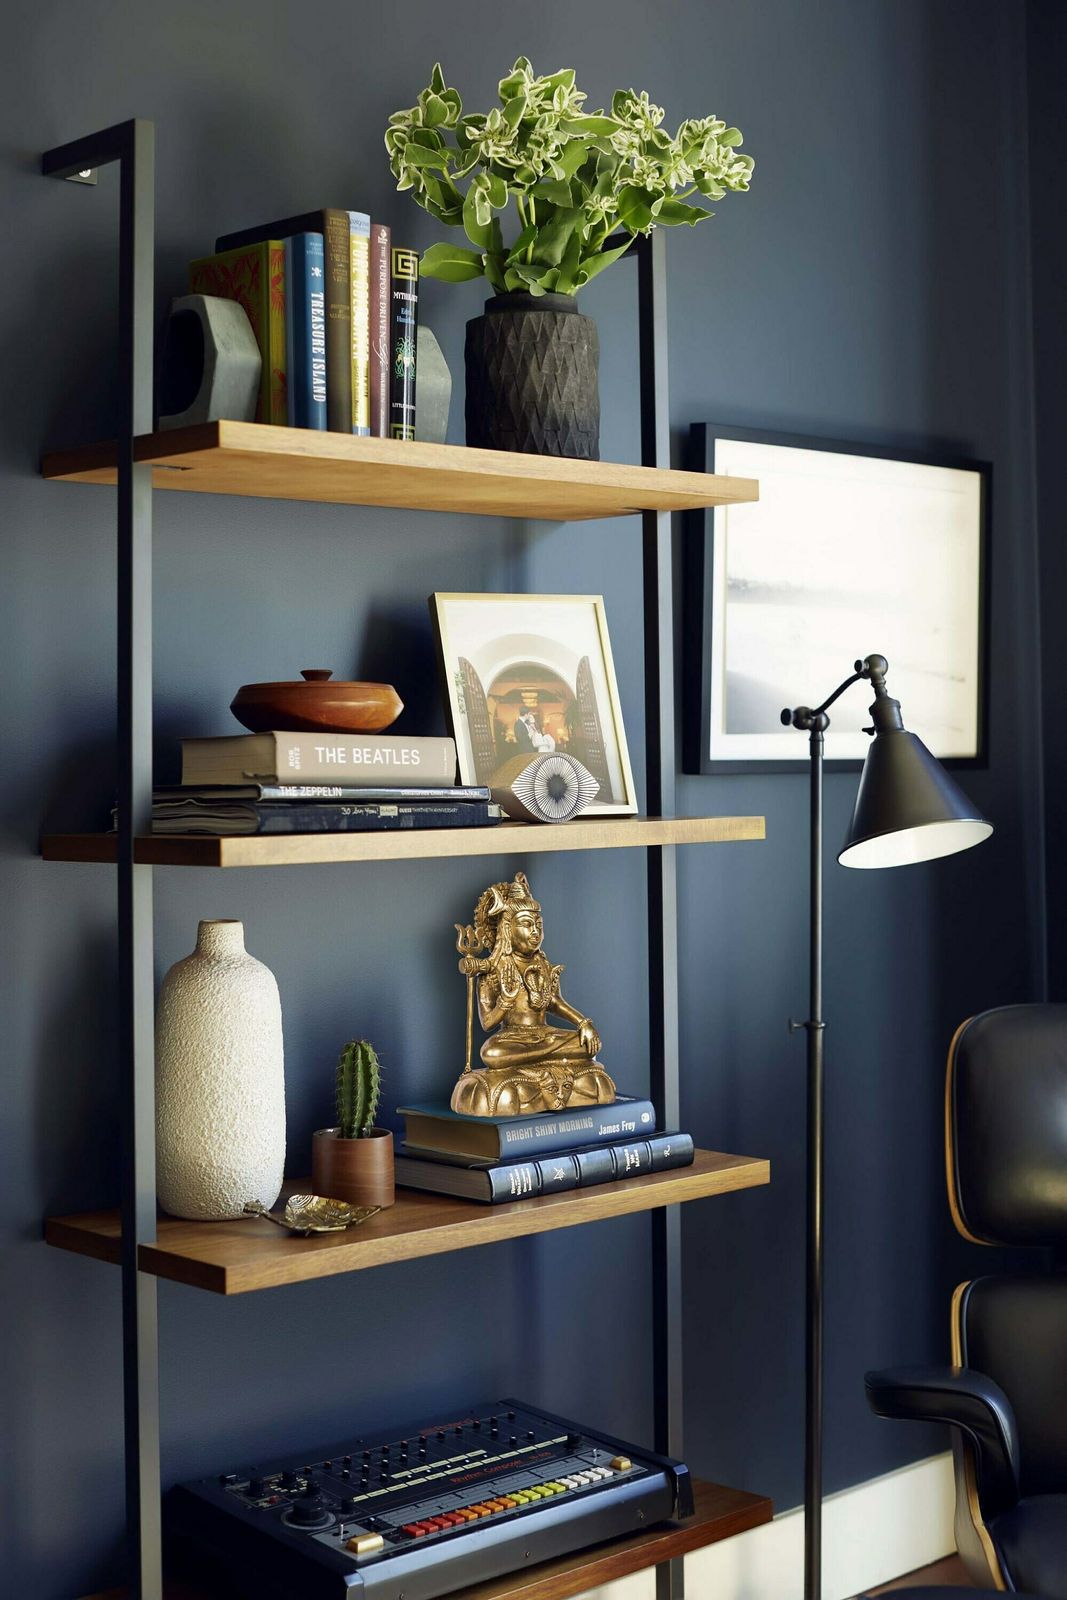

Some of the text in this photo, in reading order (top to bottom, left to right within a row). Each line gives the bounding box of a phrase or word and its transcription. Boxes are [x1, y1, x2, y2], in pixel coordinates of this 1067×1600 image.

[379, 259, 387, 300] PURPOSE
[379, 302, 387, 338] DRIVEN
[311, 292, 326, 402] TREASURE ISLAND
[314, 747, 421, 766] THE BEATLES
[279, 786, 342, 797] THE ZEPPELIN
[506, 1117, 594, 1143] BRIGHT SHINY MORNING
[598, 1121, 636, 1136] James Frey
